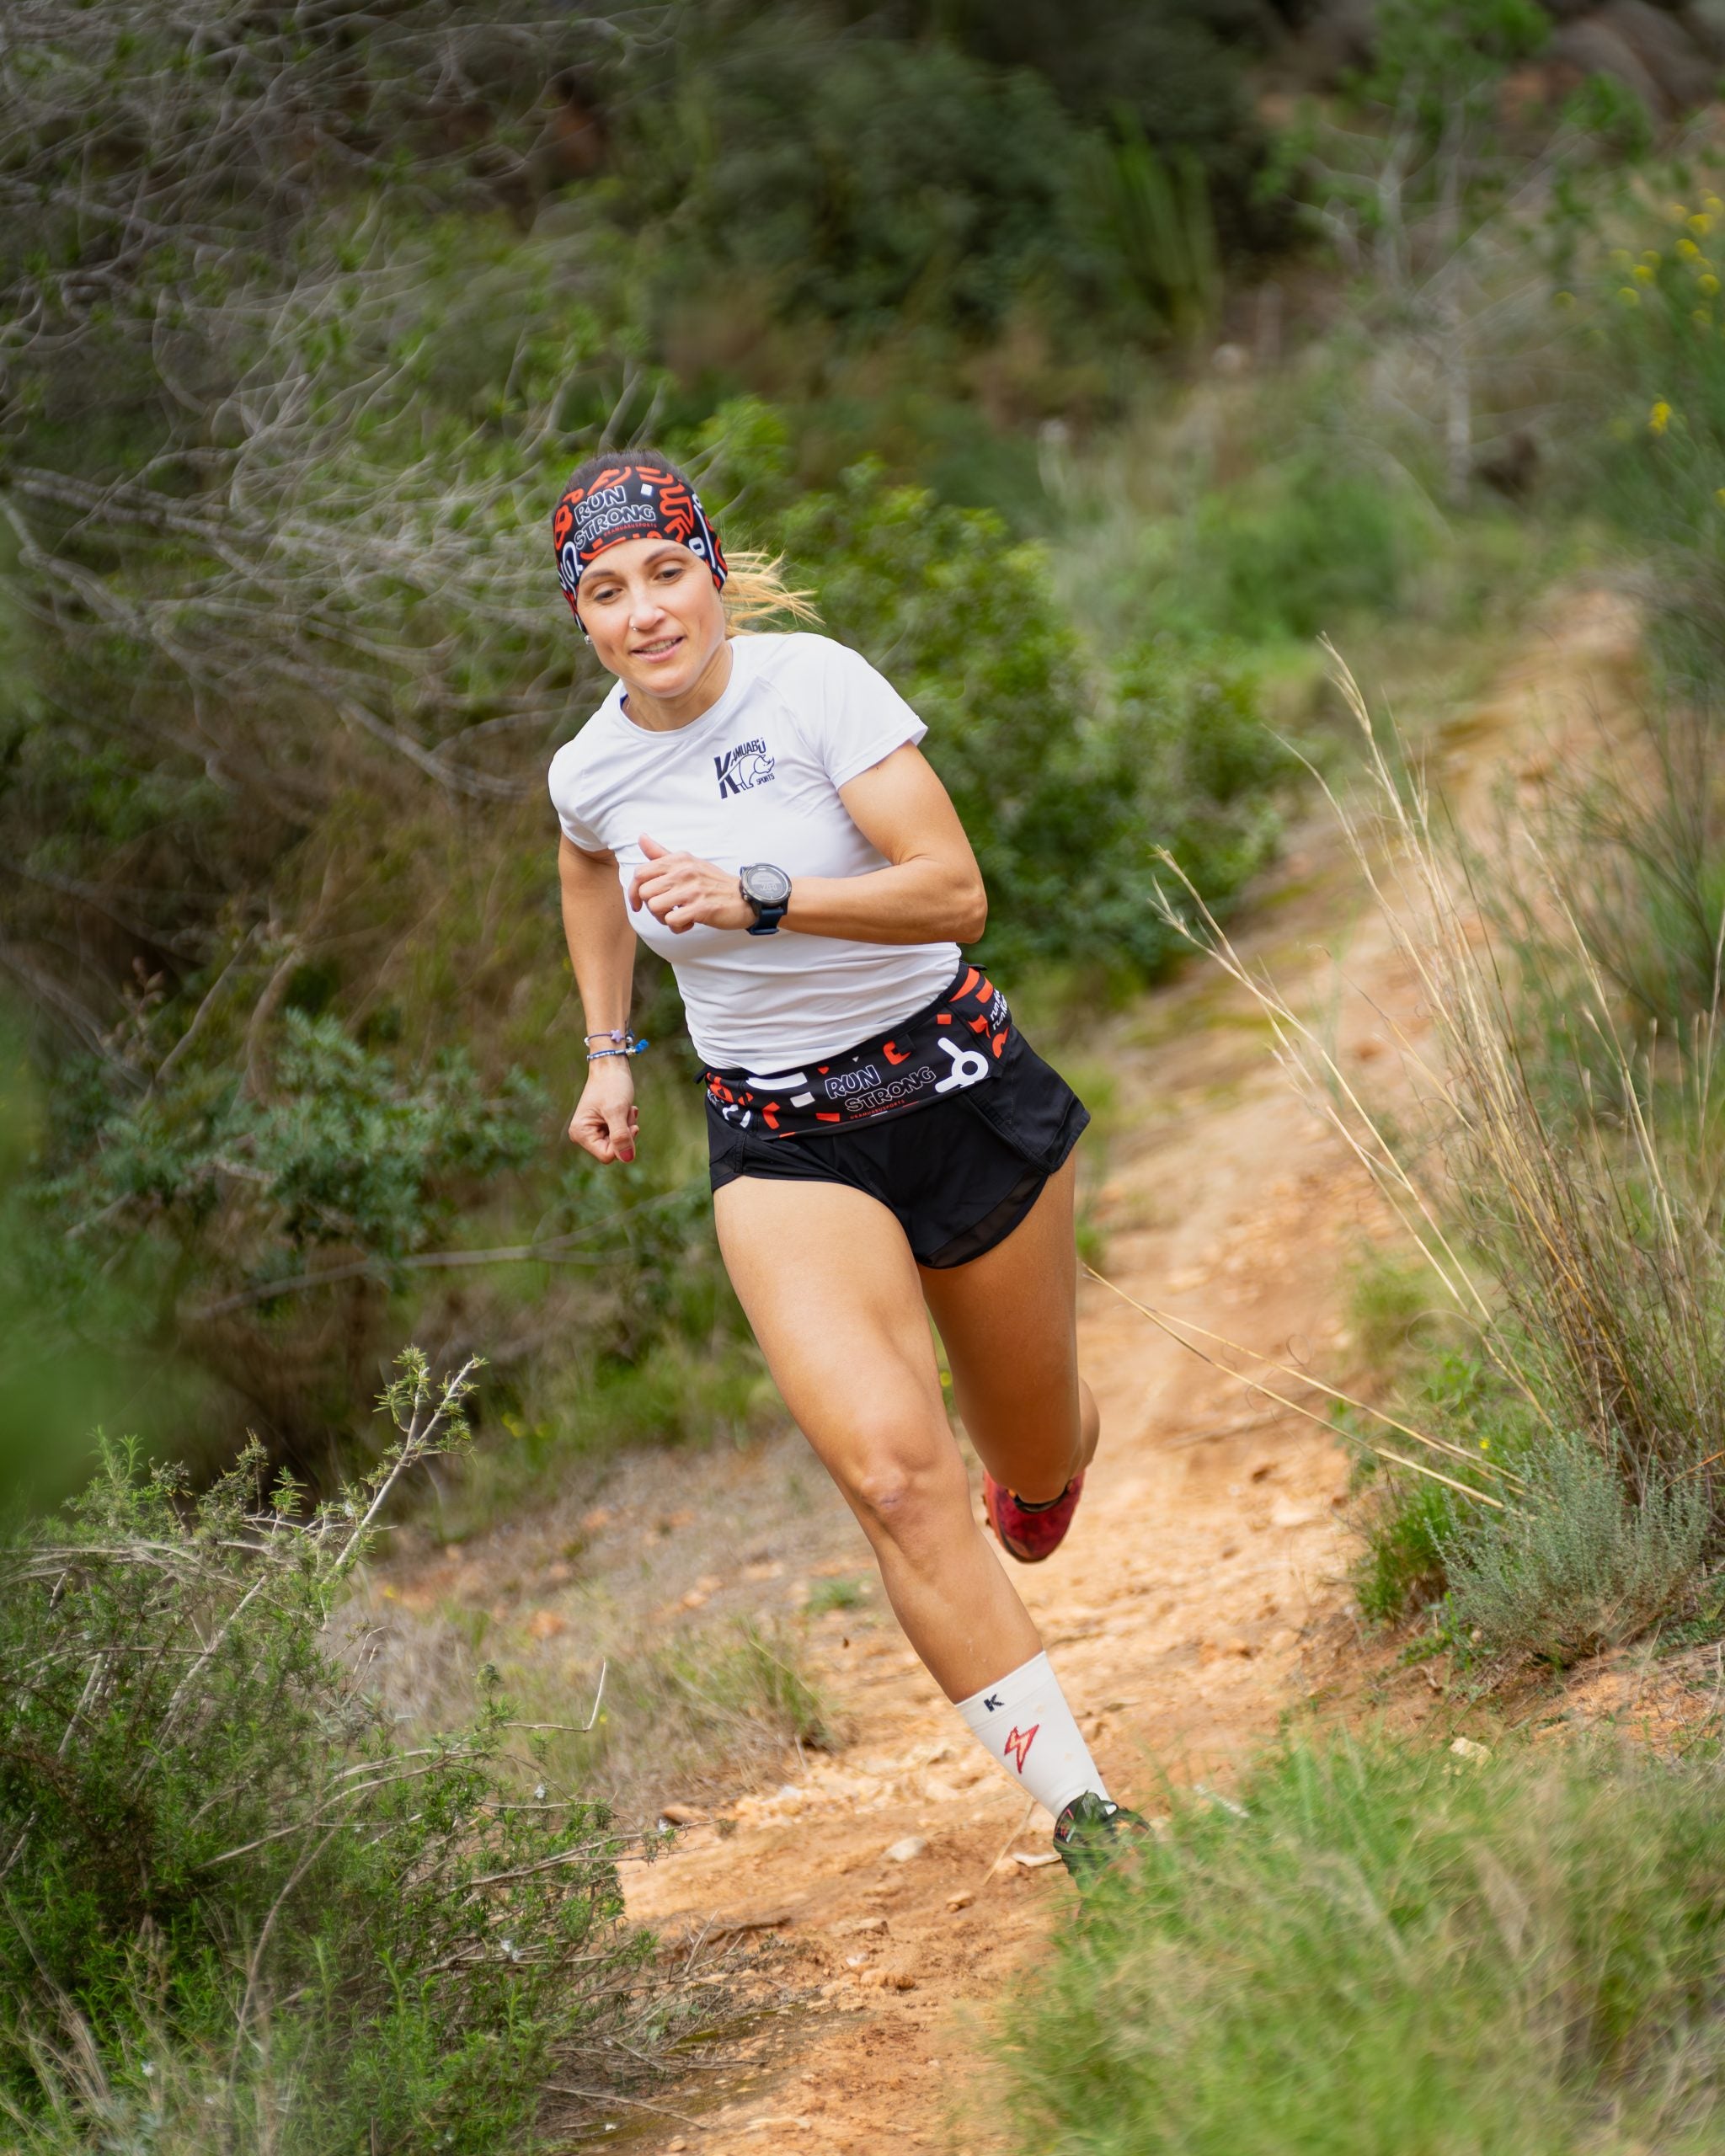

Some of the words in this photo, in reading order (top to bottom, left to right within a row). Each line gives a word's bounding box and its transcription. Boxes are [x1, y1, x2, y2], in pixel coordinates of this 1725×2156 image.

[574, 485, 626, 526] RUN
[574, 504, 656, 550] STRONG
[756, 772, 776, 785] SPORTS
[825, 1065, 882, 1099] RUN
[844, 1066, 937, 1112] STRONG
[983, 1693, 1005, 1712] K
